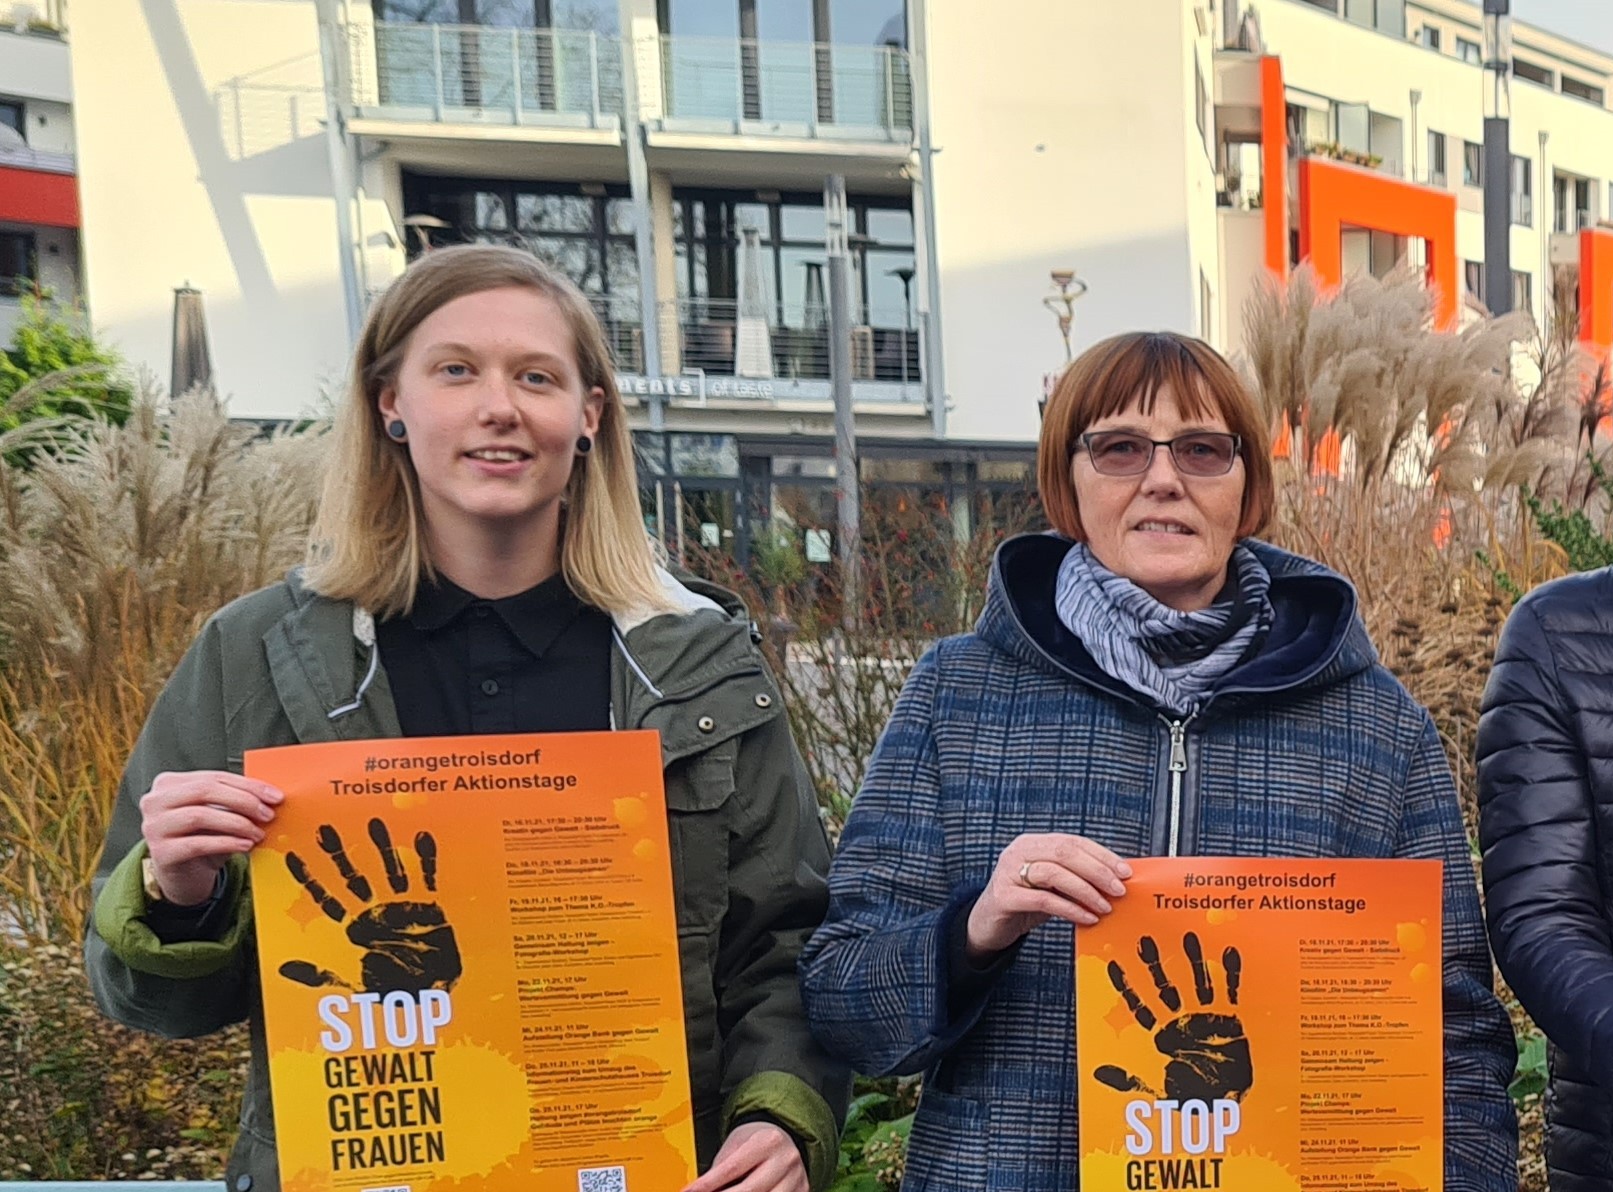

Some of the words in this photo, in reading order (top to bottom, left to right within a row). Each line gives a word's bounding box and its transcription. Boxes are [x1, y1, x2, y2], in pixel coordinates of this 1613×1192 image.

[366, 749, 540, 772] #orangetroisdorf
[330, 777, 448, 795] Troisdorfer
[454, 774, 576, 791] Aktionstage
[1185, 873, 1336, 890] #orangetroisdorf
[1153, 894, 1254, 909] Troisdorfer
[1259, 895, 1365, 913] Aktionstage
[320, 990, 451, 1051] STOP
[324, 1050, 435, 1088] GEWALT
[328, 1087, 441, 1132] GEGEN
[1127, 1101, 1240, 1154] STOP
[331, 1131, 444, 1171] FRAUEN
[1127, 1158, 1223, 1190] GEWALT
